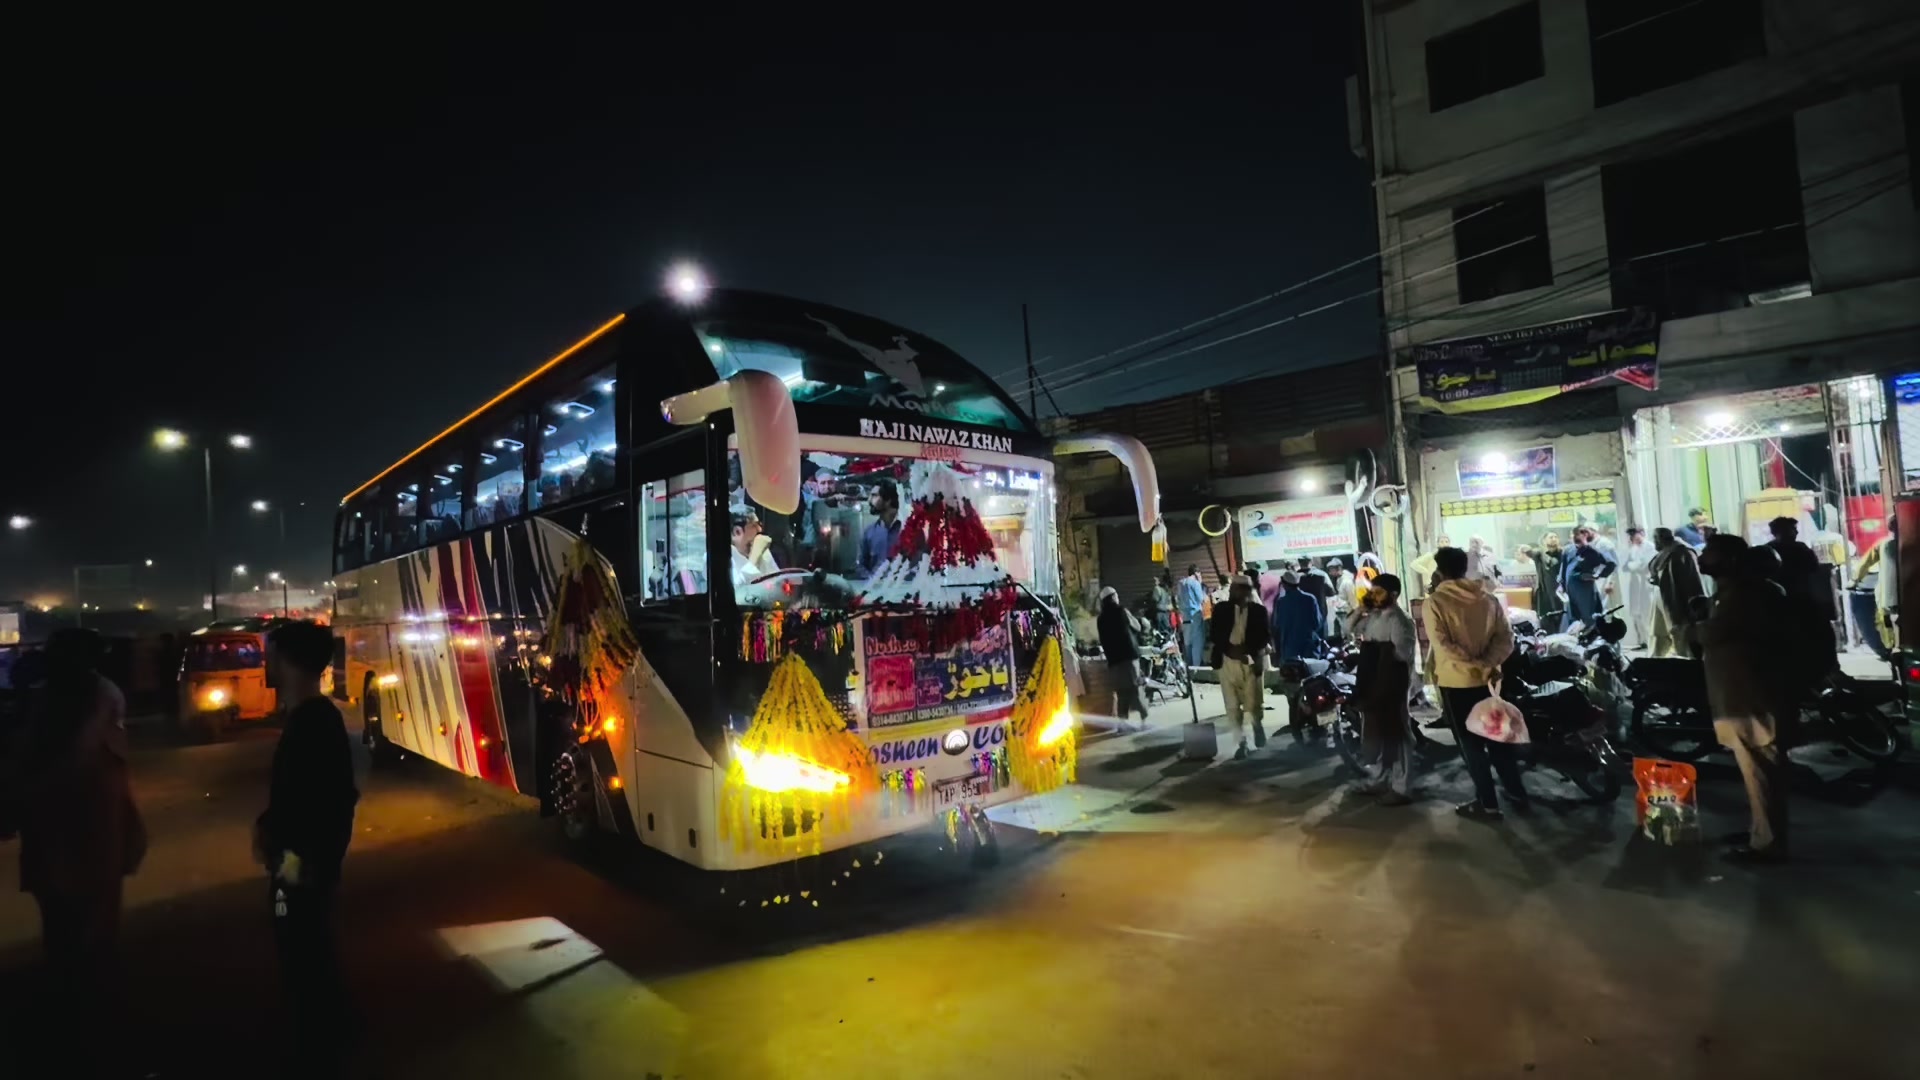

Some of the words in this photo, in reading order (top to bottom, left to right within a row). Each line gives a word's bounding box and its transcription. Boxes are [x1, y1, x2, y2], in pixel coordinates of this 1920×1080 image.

[860, 418, 906, 441] HAJI
[909, 424, 970, 447] NAWAZ
[971, 432, 1012, 453] KHAN
